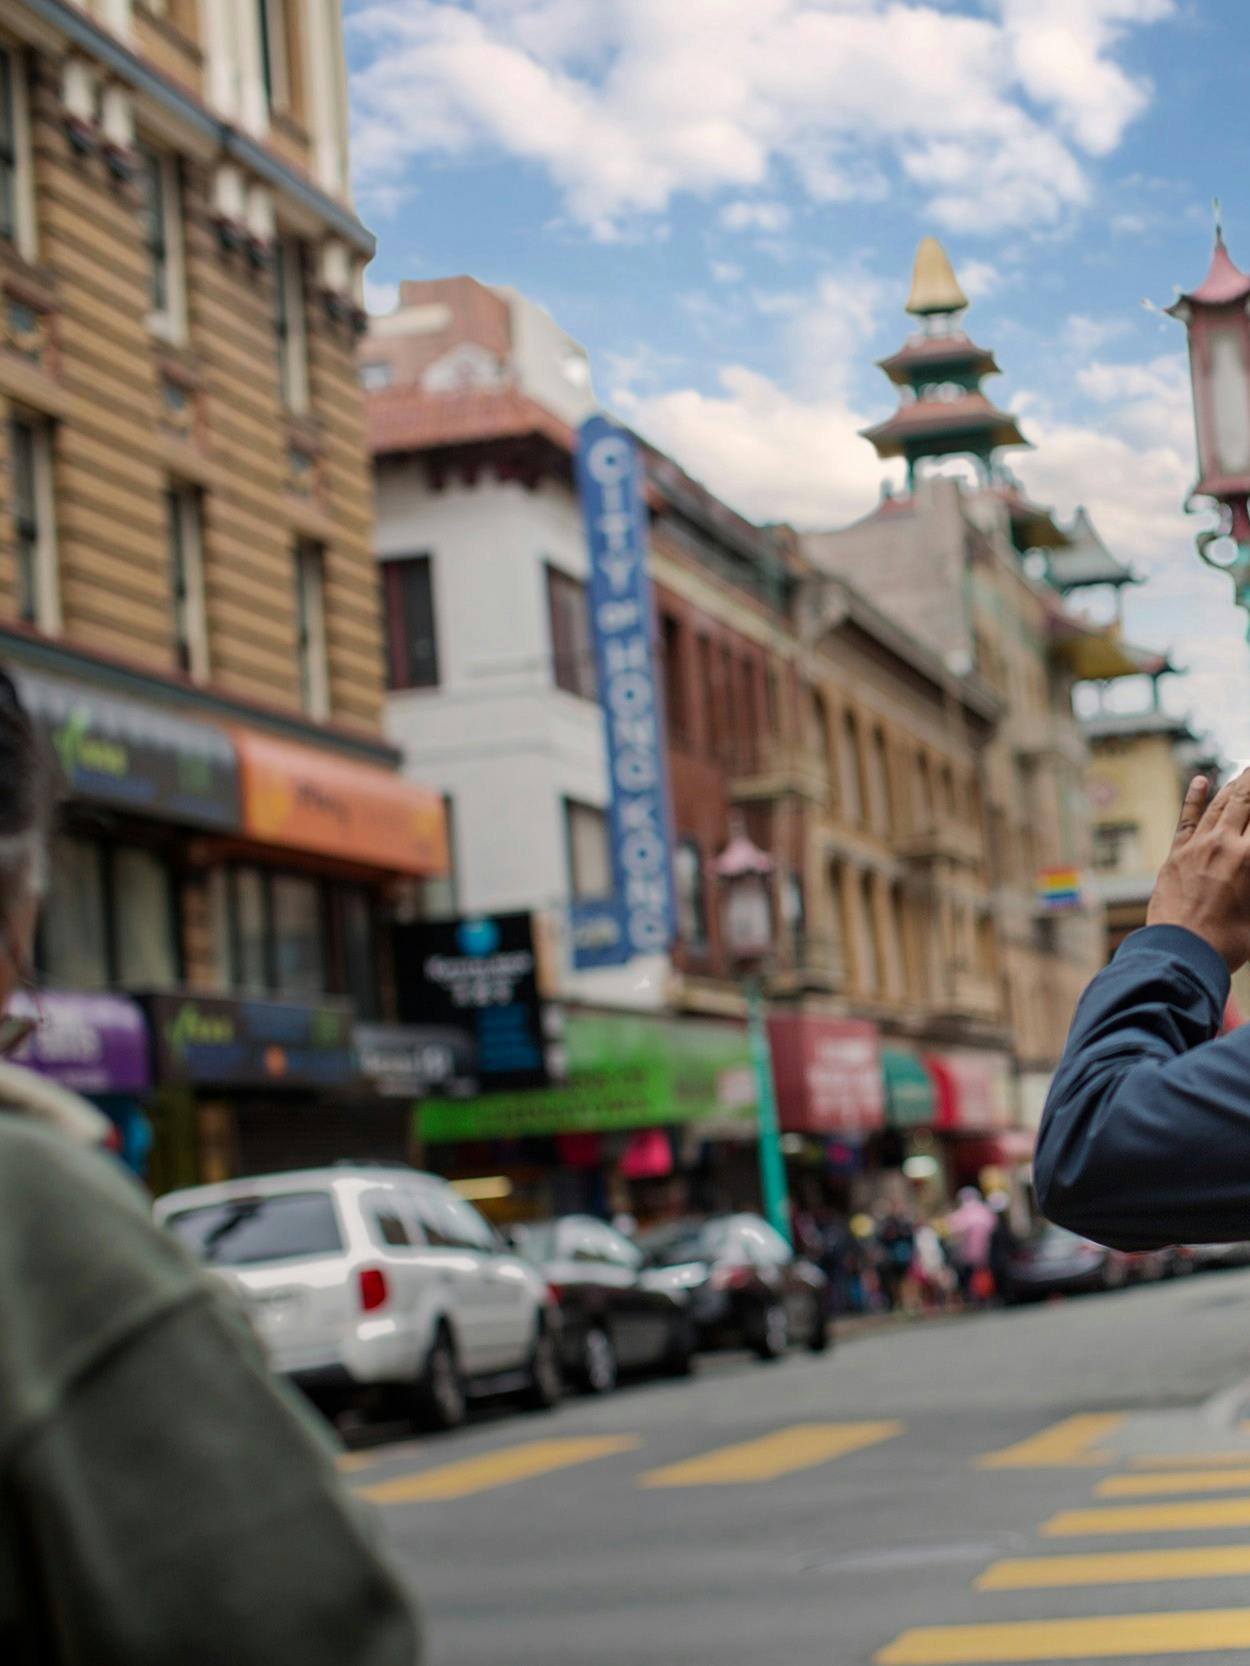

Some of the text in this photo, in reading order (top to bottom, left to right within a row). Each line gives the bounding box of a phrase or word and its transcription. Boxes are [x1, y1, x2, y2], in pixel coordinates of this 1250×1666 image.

[587, 435, 638, 594] CITY
[607, 638, 657, 793] HONG
[615, 796, 668, 951] KONG
